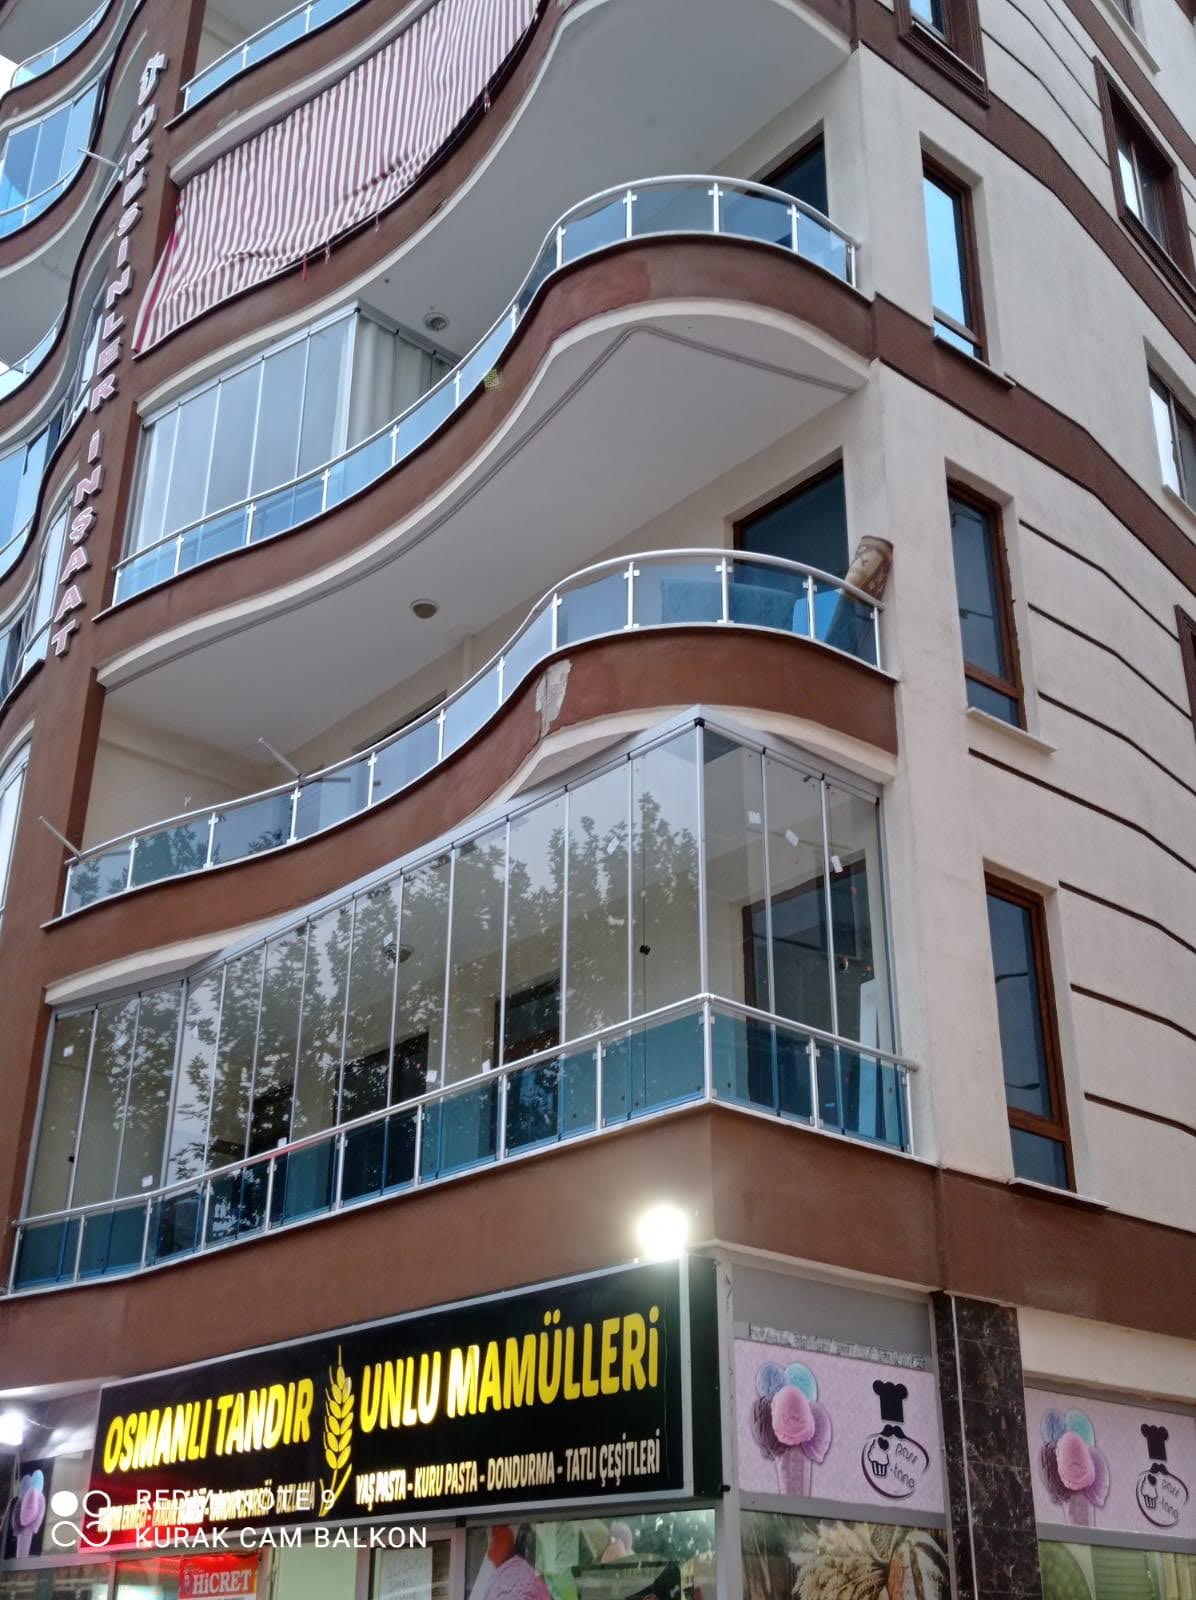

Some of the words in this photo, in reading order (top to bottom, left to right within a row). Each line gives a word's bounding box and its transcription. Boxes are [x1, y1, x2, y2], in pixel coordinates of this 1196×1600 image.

[103, 1398, 213, 1474] OSMANLI
[215, 1378, 315, 1456] TANDIR
[359, 1350, 442, 1433] UNLU
[413, 1463, 444, 1499] KURU
[444, 1459, 479, 1495] PASTA
[486, 1450, 555, 1491] DONDURMA
[565, 1444, 598, 1483] TATLI
